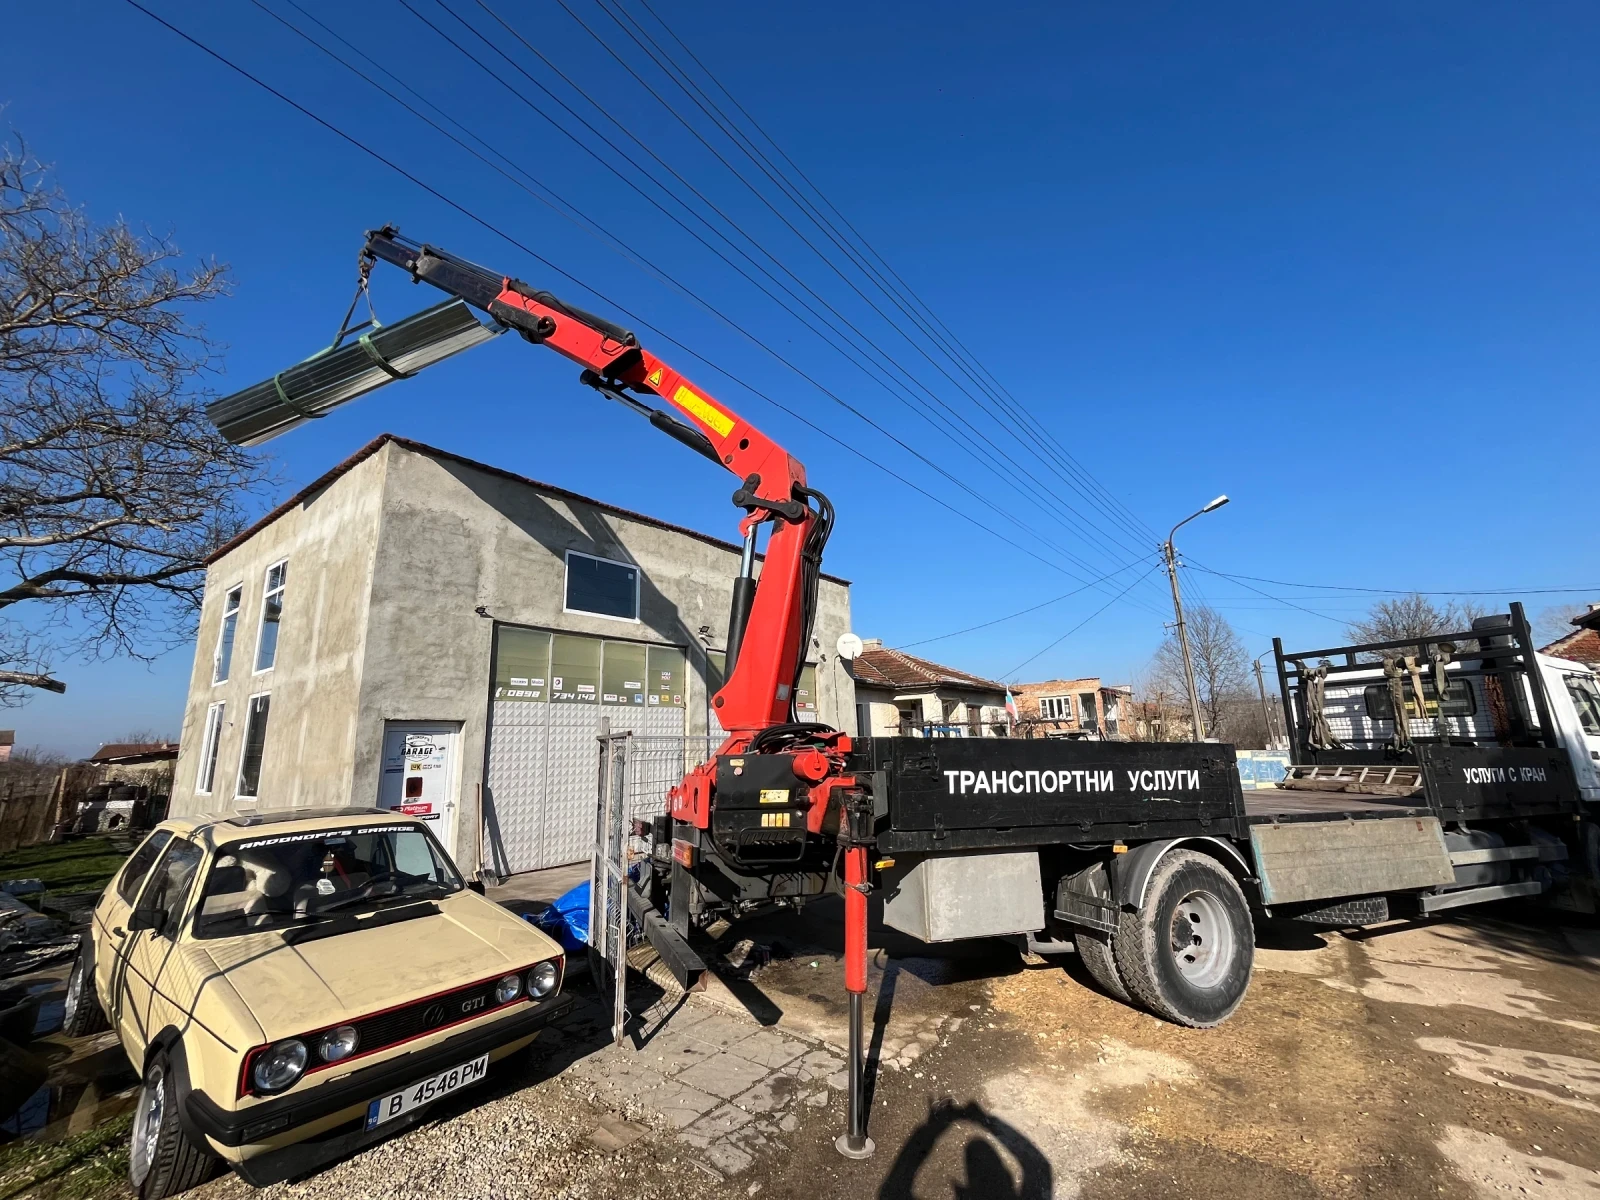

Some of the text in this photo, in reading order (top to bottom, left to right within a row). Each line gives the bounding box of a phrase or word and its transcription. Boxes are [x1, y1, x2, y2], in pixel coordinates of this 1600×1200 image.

[553, 692, 575, 700] 734
[577, 693, 596, 701] 143
[943, 769, 1201, 795] ТРАНСПОРТНИ УСЛУГИ
[1462, 767, 1506, 784] УСЛУГИ
[1520, 767, 1547, 782] КРАН
[238, 829, 352, 850] ANDONOFF'S
[461, 996, 486, 1013] GTI
[388, 1094, 403, 1116] B
[412, 1070, 459, 1104] 4548
[461, 1057, 486, 1084] PM
